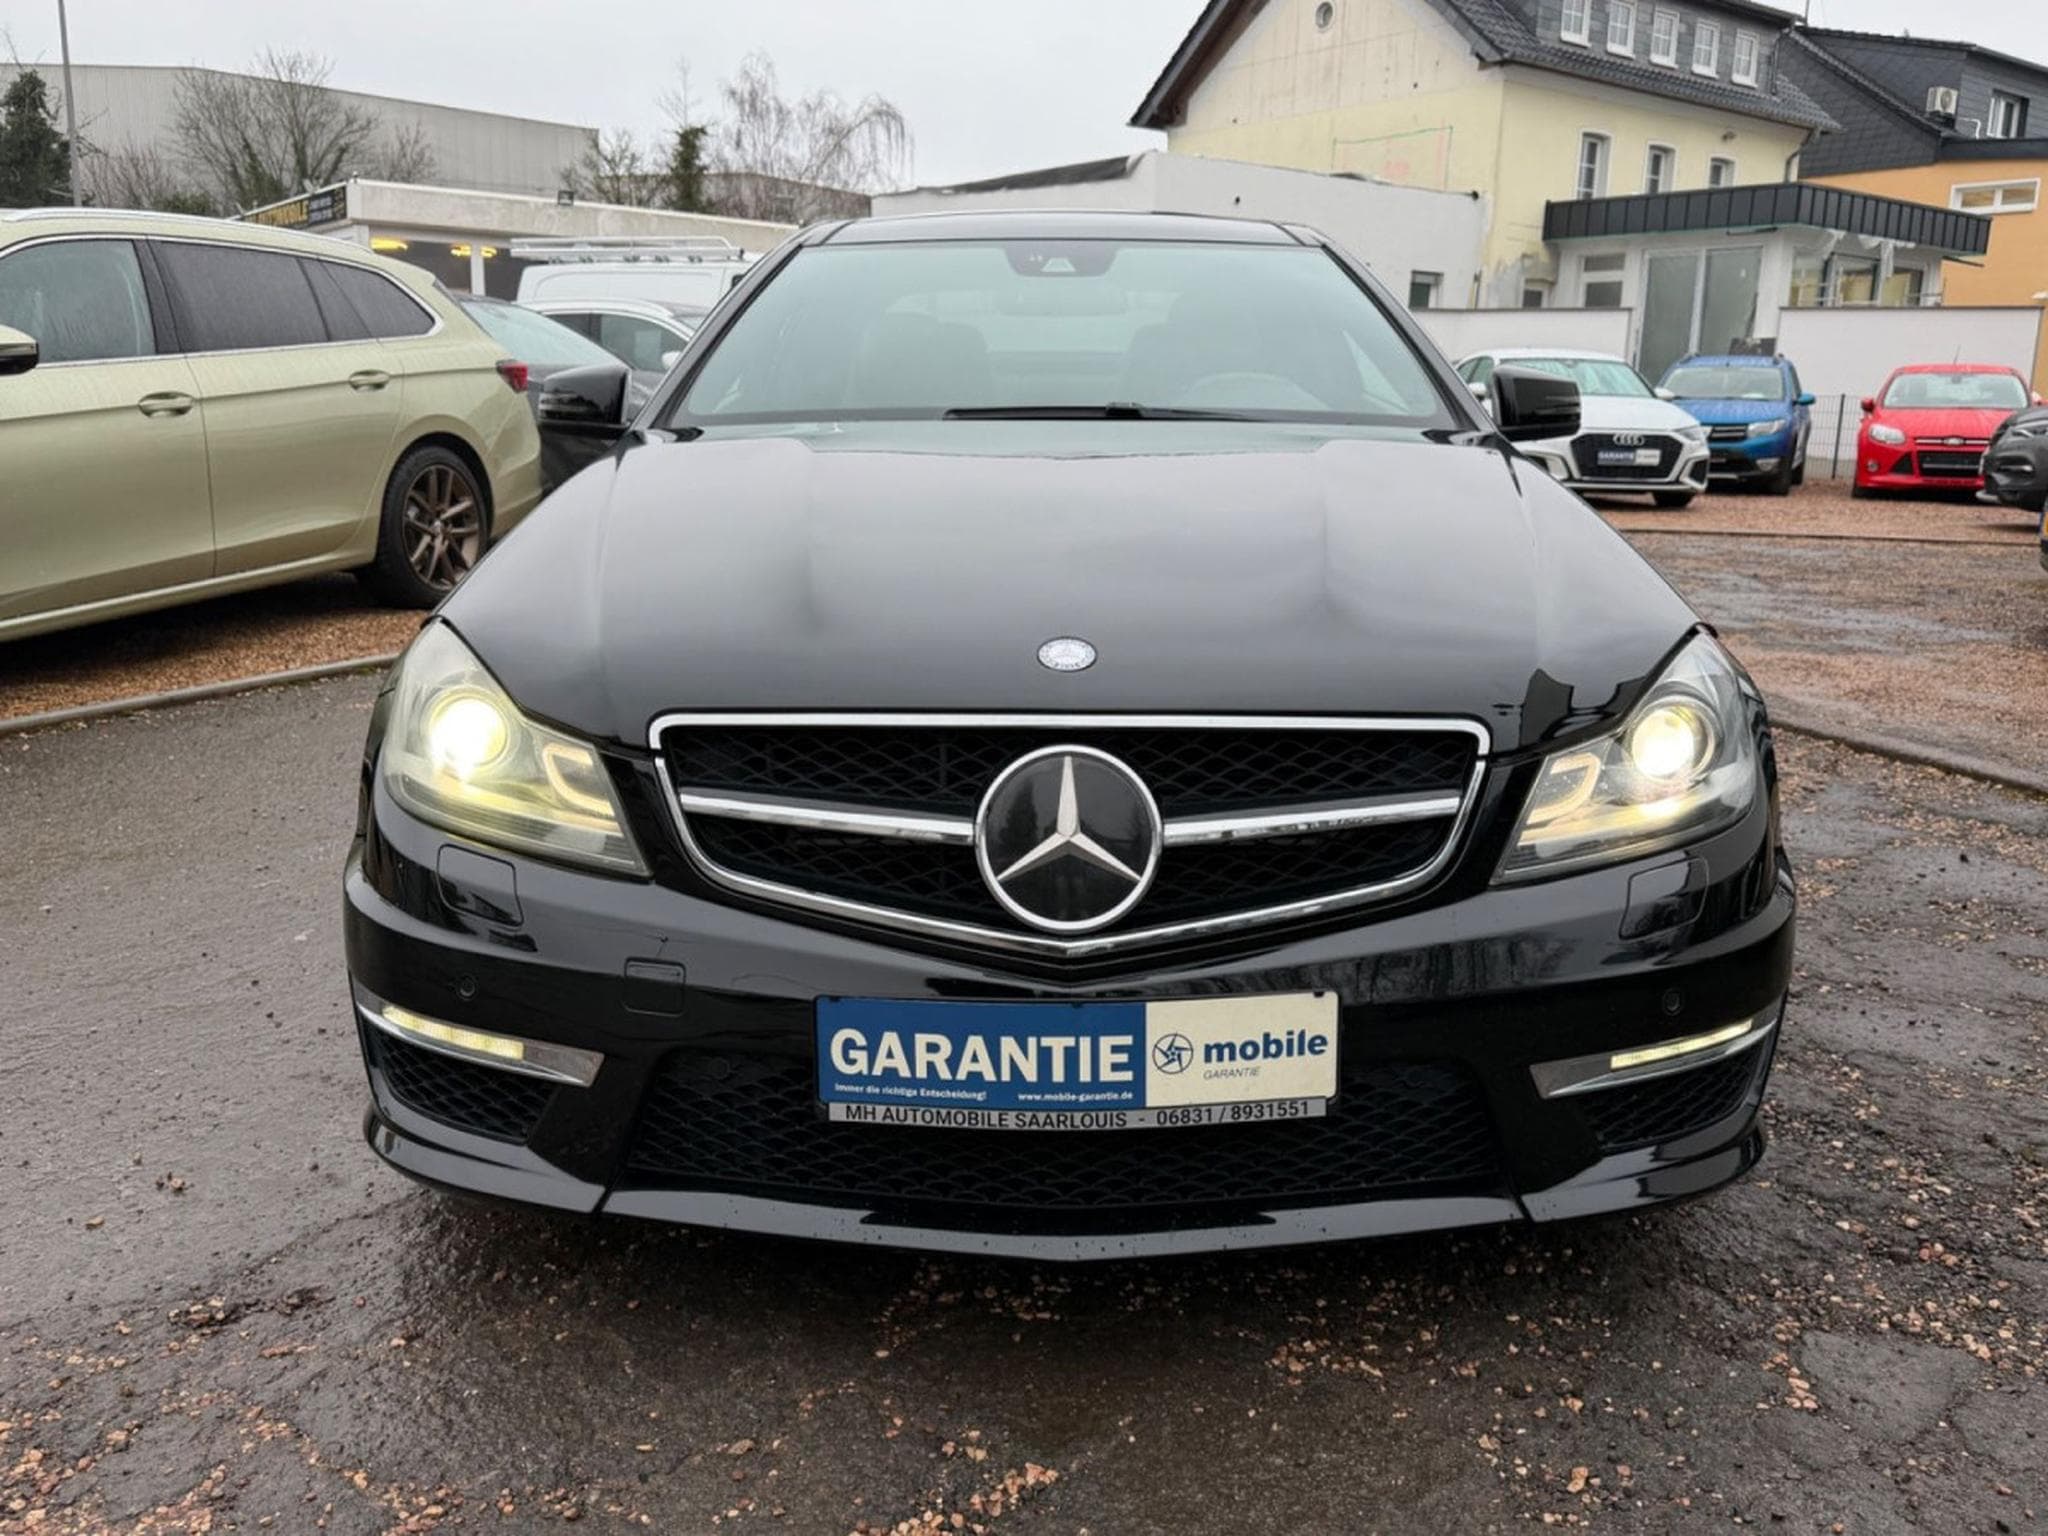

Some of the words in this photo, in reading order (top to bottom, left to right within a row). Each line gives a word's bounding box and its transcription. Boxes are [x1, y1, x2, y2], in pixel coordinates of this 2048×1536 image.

[830, 1028, 1134, 1083] GARANTIE
[1203, 1029, 1328, 1064] mobile
[1203, 1066, 1261, 1080] GARANTIE
[835, 1083, 864, 1093] Immer
[866, 1084, 880, 1094] die
[882, 1085, 917, 1097] richtige
[919, 1088, 987, 1101] Entscheidung!
[1018, 1091, 1133, 1102] www.mobile-garantie.de
[846, 1105, 876, 1121] MH
[882, 1107, 1009, 1128] AUTOMOBILE
[1015, 1112, 1127, 1129] SAARLOUIS
[1156, 1107, 1213, 1126] 06831
[1218, 1106, 1227, 1124] /
[1231, 1101, 1309, 1121] 8931551
